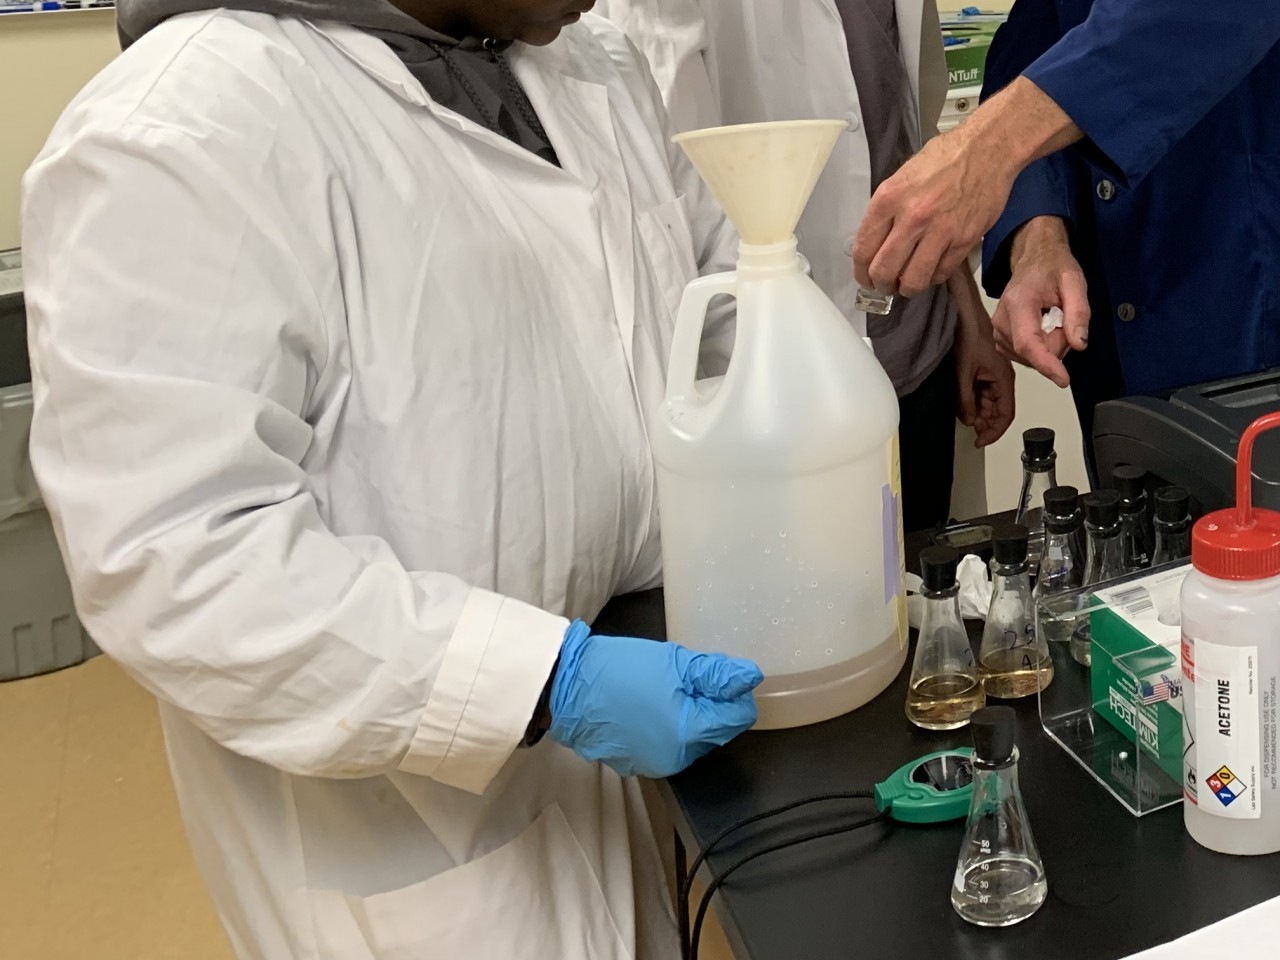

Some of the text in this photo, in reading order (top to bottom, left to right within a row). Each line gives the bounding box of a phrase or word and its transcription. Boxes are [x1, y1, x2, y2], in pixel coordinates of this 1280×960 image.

[1217, 679, 1231, 737] ACETONE
[1210, 778, 1222, 789] 3
[1220, 791, 1233, 804] 1
[981, 840, 990, 848] 50
[981, 863, 989, 871] 40
[980, 881, 989, 889] 30
